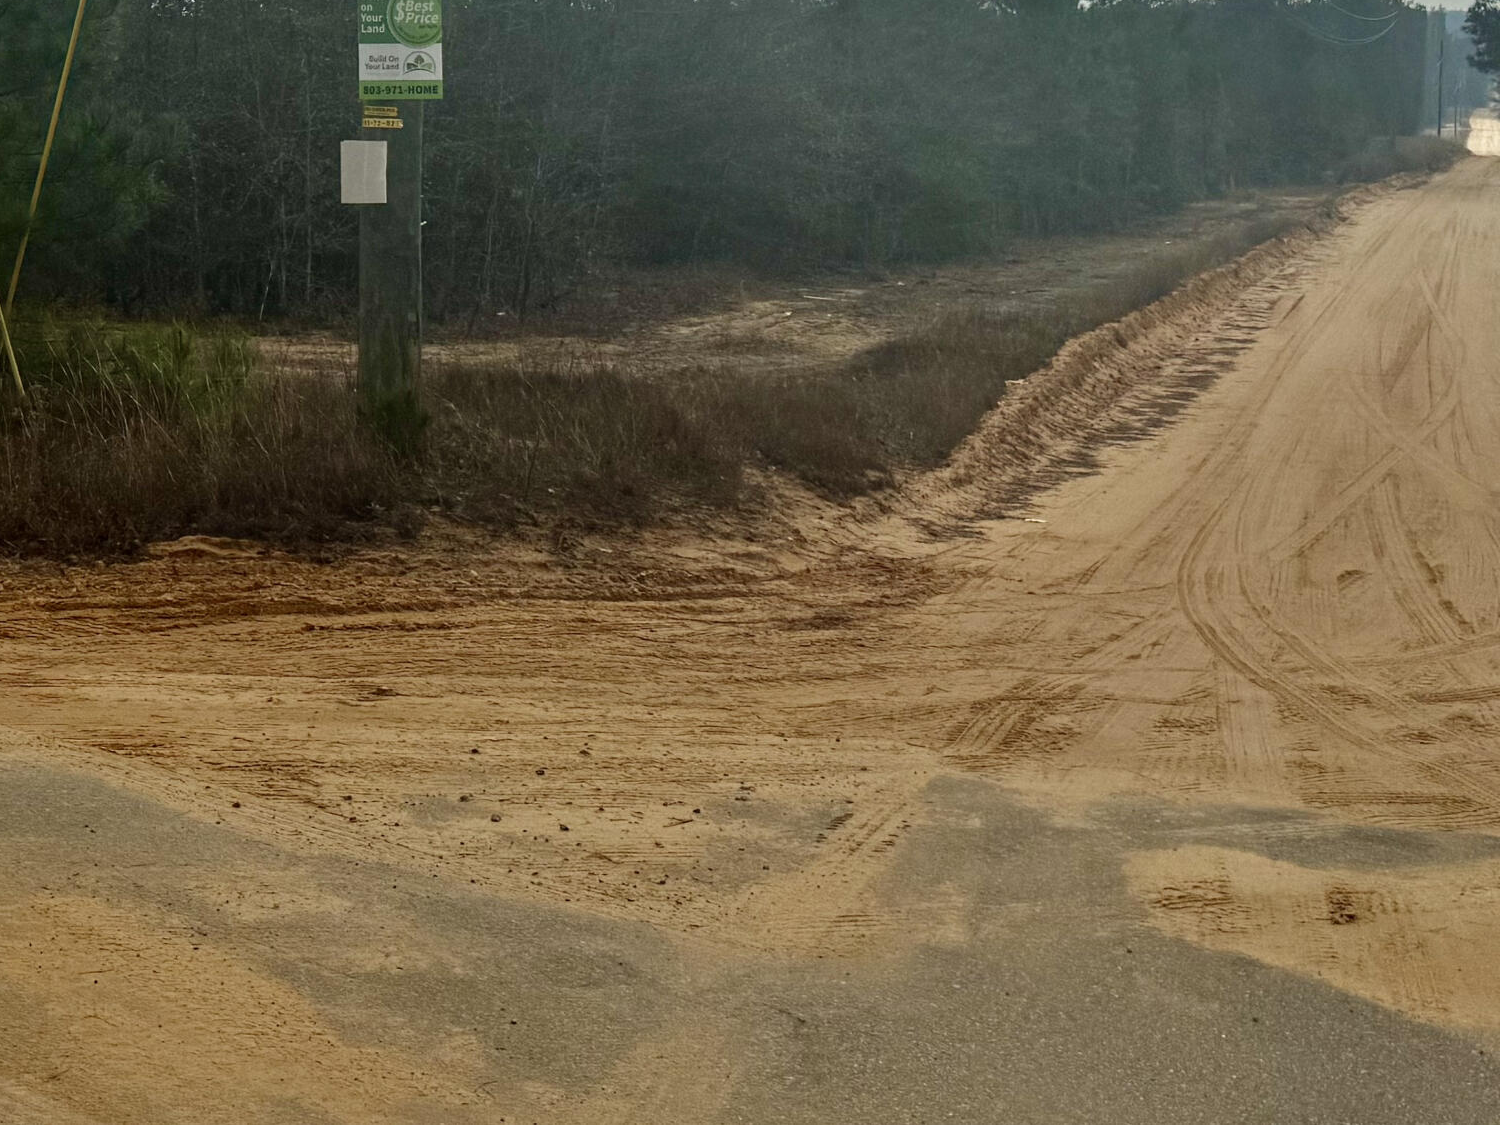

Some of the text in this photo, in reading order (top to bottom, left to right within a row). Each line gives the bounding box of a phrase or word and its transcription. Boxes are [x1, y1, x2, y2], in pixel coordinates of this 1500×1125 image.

[361, 4, 373, 12] on
[405, 0, 435, 12] Best
[361, 13, 383, 23] Your
[405, 10, 439, 24] Price
[361, 24, 385, 33] Land
